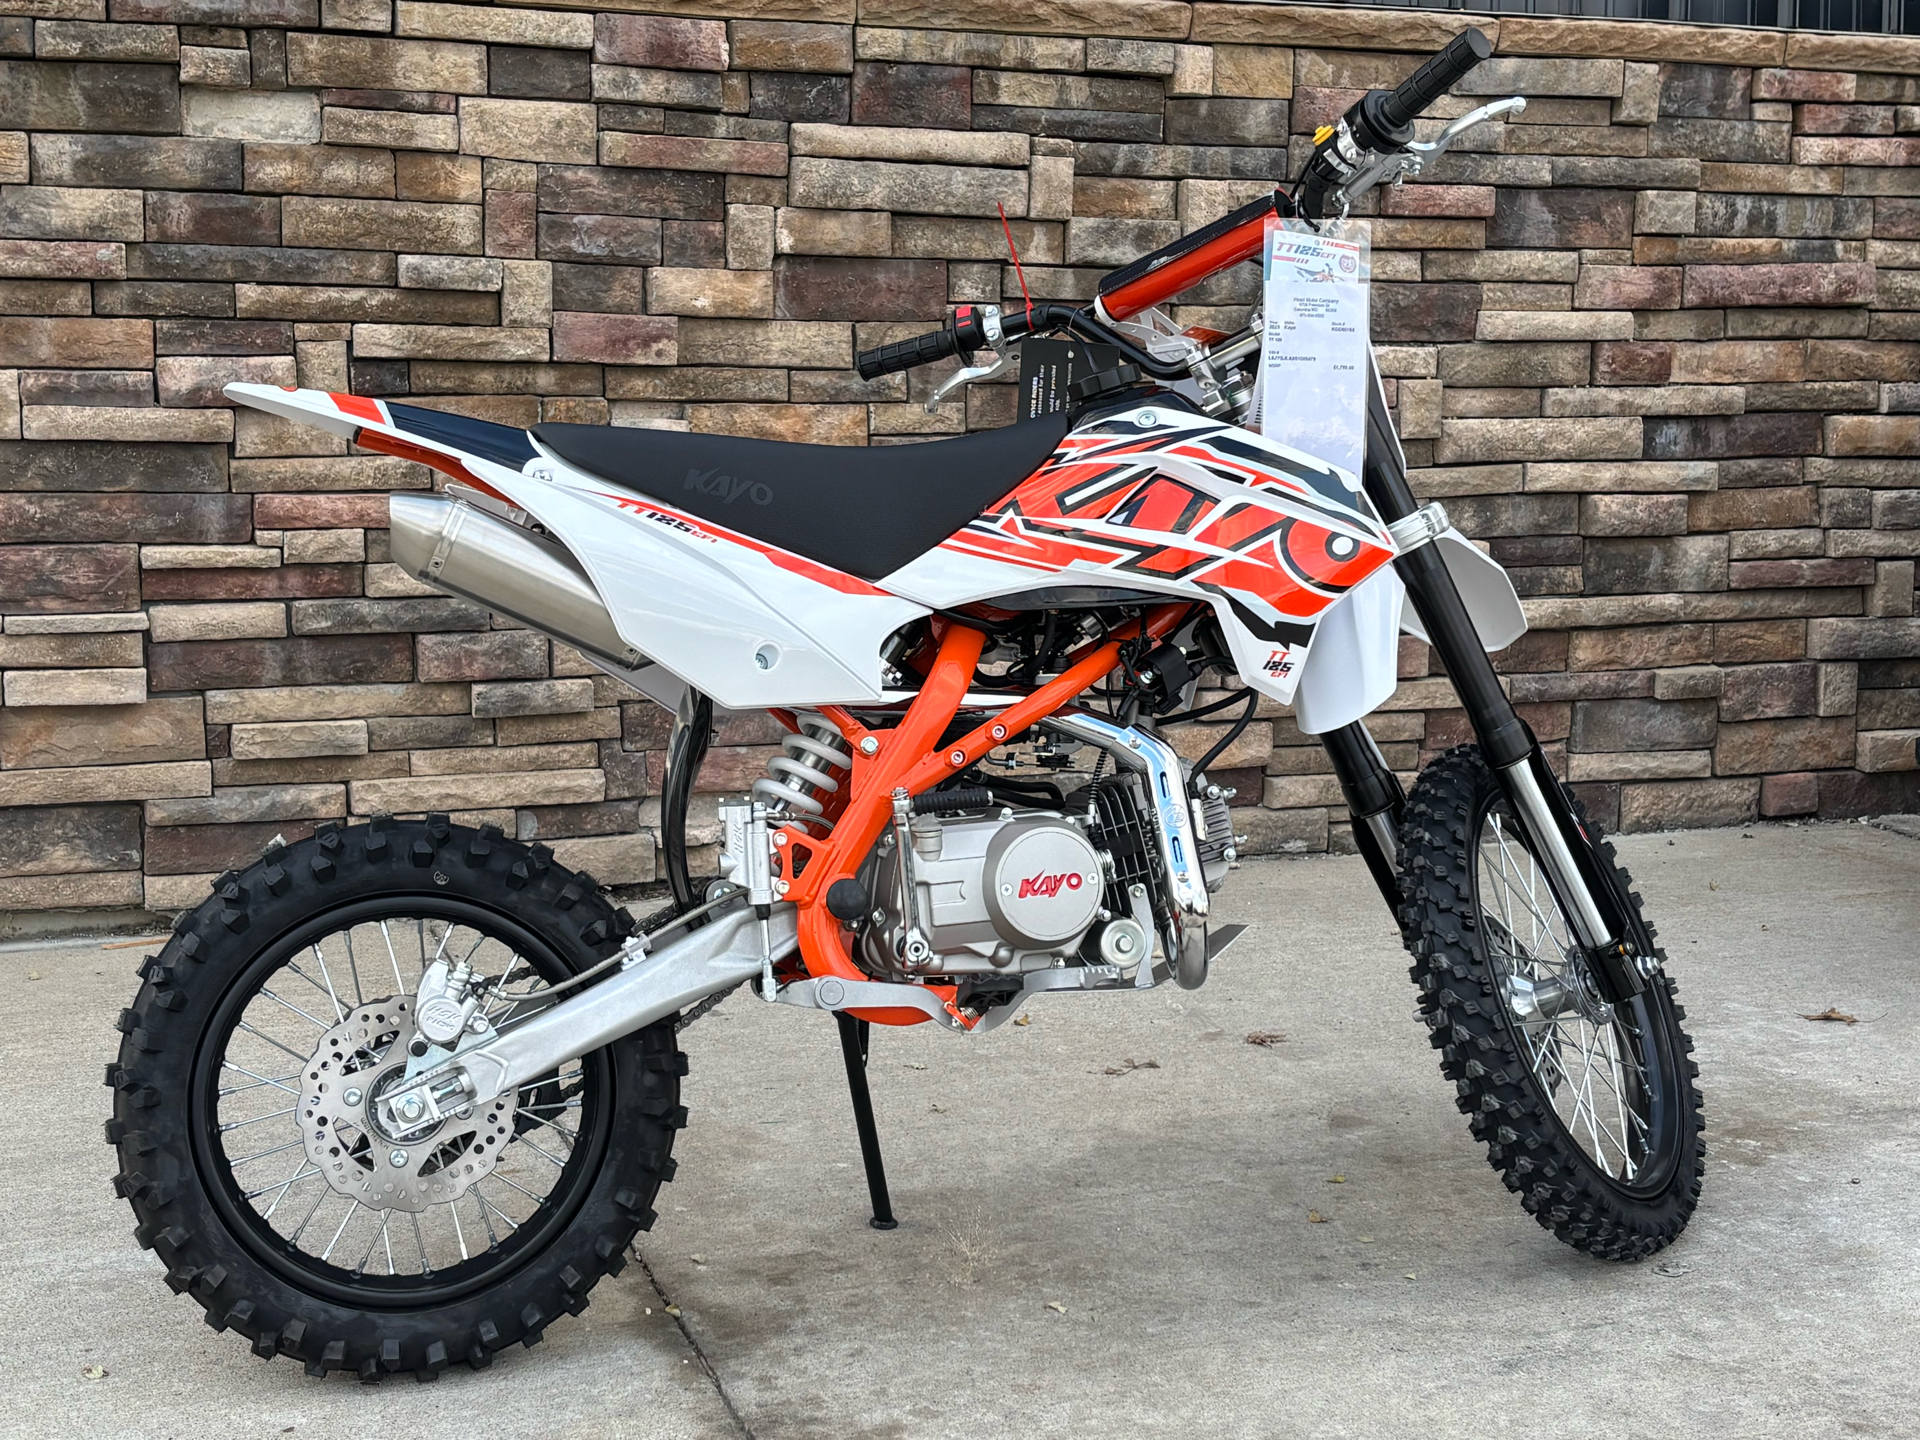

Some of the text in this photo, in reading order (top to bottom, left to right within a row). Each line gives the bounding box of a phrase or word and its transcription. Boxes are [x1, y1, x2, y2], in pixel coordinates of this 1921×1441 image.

[683, 467, 773, 506] KAYO
[1262, 660, 1295, 672] 125
[1269, 650, 1291, 662] TT
[1018, 869, 1083, 899] KAYO
